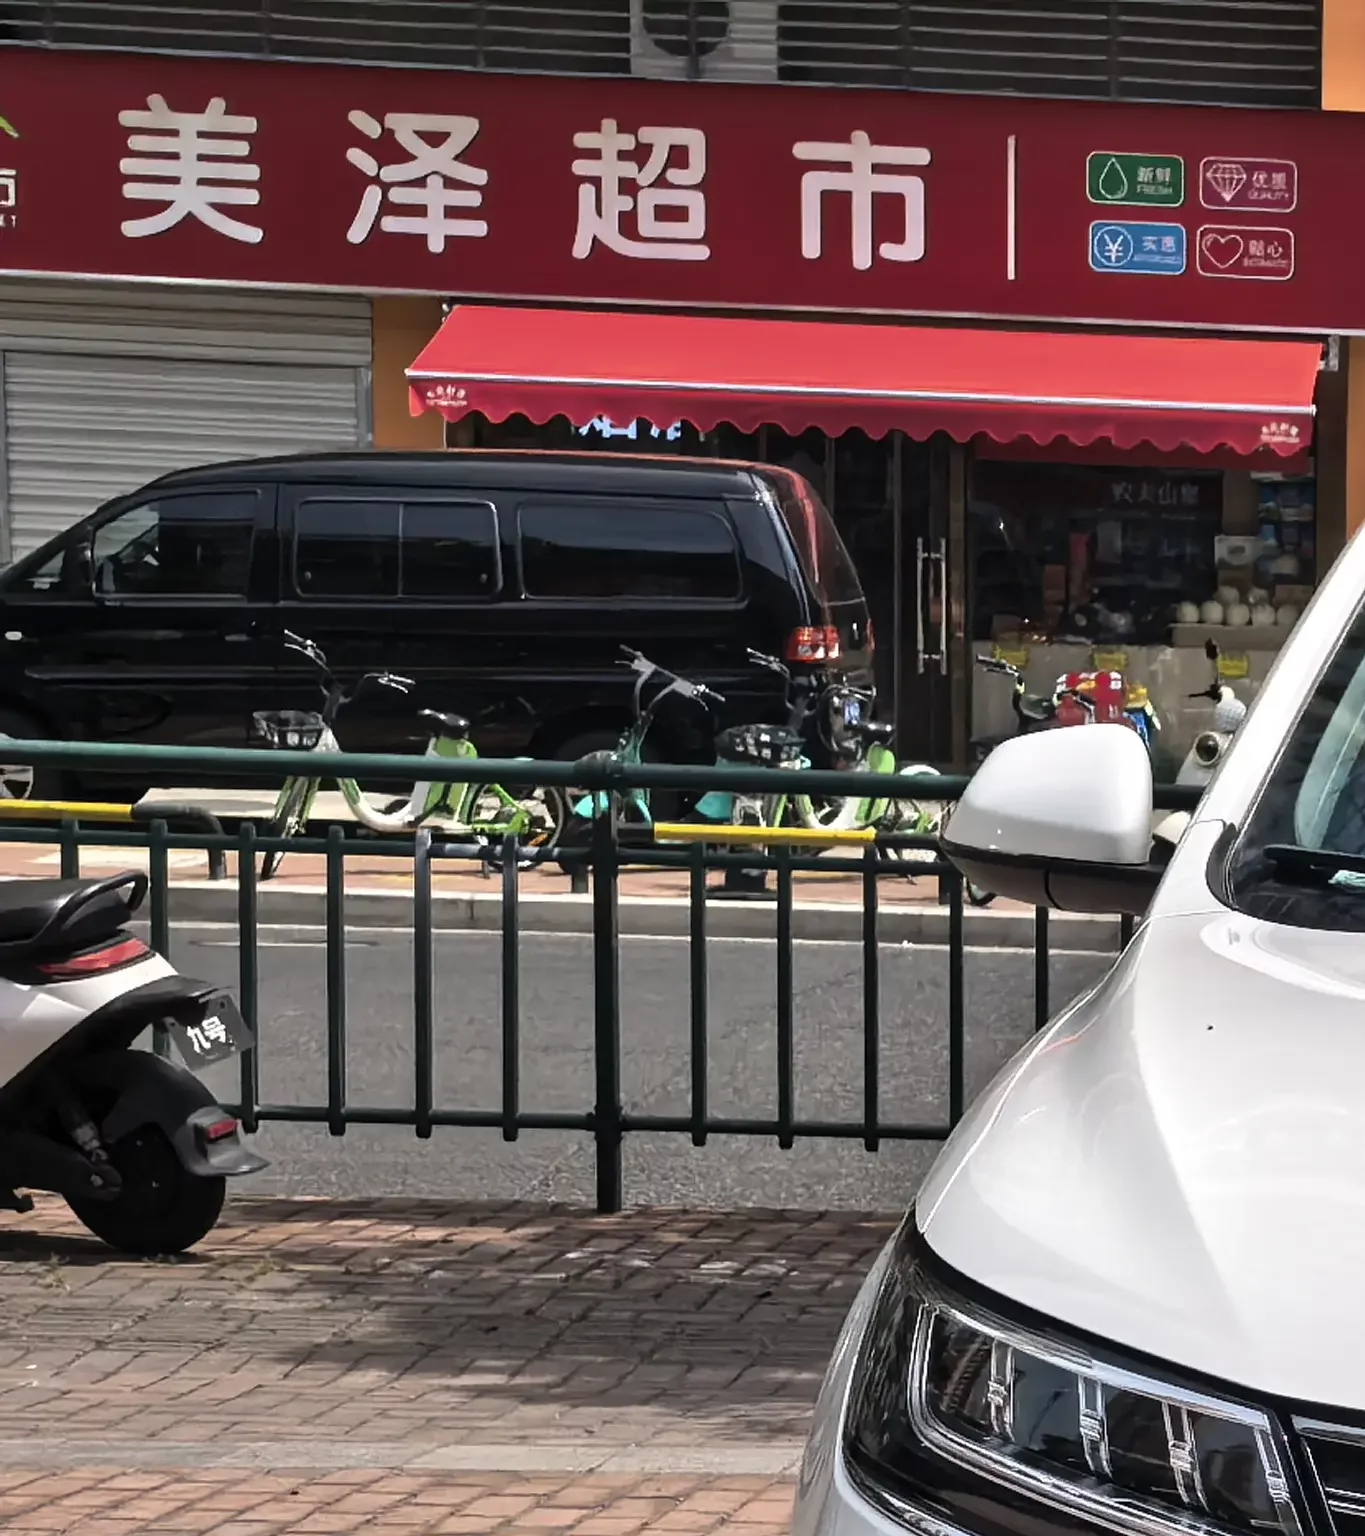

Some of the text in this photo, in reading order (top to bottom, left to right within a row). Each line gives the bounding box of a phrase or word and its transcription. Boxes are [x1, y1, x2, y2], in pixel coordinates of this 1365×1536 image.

[117, 93, 933, 271] 美泽超市
[186, 1015, 227, 1054] 九号
